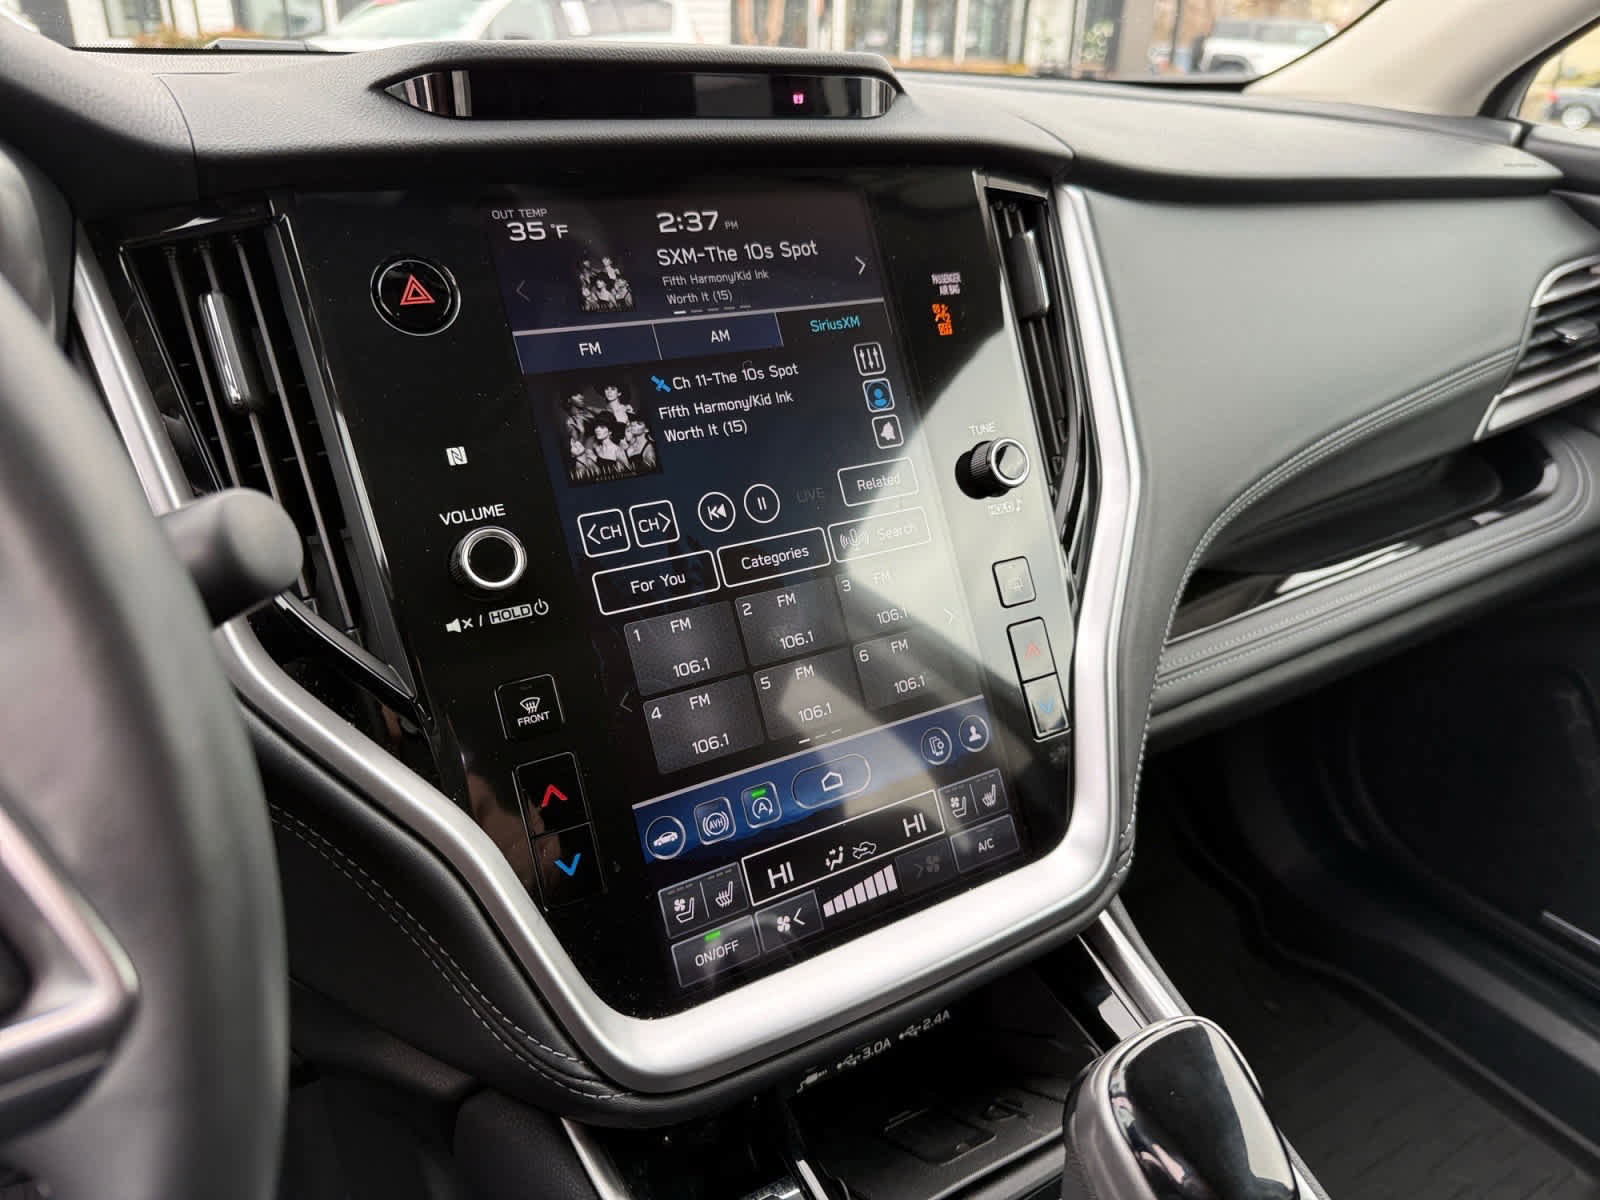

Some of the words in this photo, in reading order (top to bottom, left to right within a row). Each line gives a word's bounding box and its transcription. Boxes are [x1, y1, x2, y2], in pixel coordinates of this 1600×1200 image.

[491, 209, 514, 220] OUT
[518, 207, 548, 218] TEMP
[656, 210, 719, 233] 2:37
[724, 220, 739, 230] PM
[507, 221, 547, 241] 35
[656, 246, 738, 266] SXM-The
[743, 243, 774, 260] 10s
[779, 239, 819, 260] Spot
[662, 275, 687, 286] Fifth
[690, 271, 752, 285] Harmony/Kid
[754, 269, 769, 280] Ink
[666, 293, 699, 305] Worth
[701, 291, 710, 302] It
[712, 289, 733, 303] (15)
[809, 315, 861, 332] SiriusXM
[710, 329, 731, 343] AM
[578, 341, 602, 356] FM
[672, 376, 692, 391] Ch
[695, 371, 738, 388] 11-The
[741, 367, 766, 382] 10s
[768, 362, 799, 380] Spot
[658, 406, 691, 421] Fifth
[693, 393, 773, 416] Harmony/Kid
[775, 390, 795, 404] Ink
[664, 425, 705, 443] Worth
[708, 423, 719, 437] It
[722, 418, 748, 438] (15)
[968, 423, 996, 435] TUNE
[856, 472, 901, 492] Related
[439, 503, 507, 526] VOLUME
[599, 524, 623, 541] CH
[638, 515, 661, 534] CH
[741, 546, 810, 571] Categories
[630, 579, 655, 595] For
[659, 572, 687, 589] You
[841, 578, 853, 593] 3
[742, 602, 754, 617] 2
[776, 592, 798, 609] FM
[489, 604, 533, 625] HOLD
[876, 606, 909, 625] 106.1
[670, 617, 693, 634] FM
[632, 628, 642, 643] 1
[779, 630, 815, 650] 106.1
[858, 648, 870, 664] 6
[890, 638, 909, 655] FM
[672, 656, 711, 678] 106.1
[794, 664, 816, 681] FM
[760, 676, 772, 691] 5
[893, 675, 927, 696] 106.1
[689, 693, 712, 711] FM
[798, 701, 834, 722] 106.1
[517, 711, 551, 728] FRONT
[650, 705, 663, 722] 4
[691, 732, 731, 754] 106.1
[709, 818, 724, 831] AVH
[902, 812, 927, 836] HI
[977, 837, 995, 852] A/C
[767, 861, 794, 889] HI
[694, 941, 740, 967] ON/OFF
[923, 1009, 951, 1030] 2.4A
[863, 1037, 892, 1059] 3.0A
